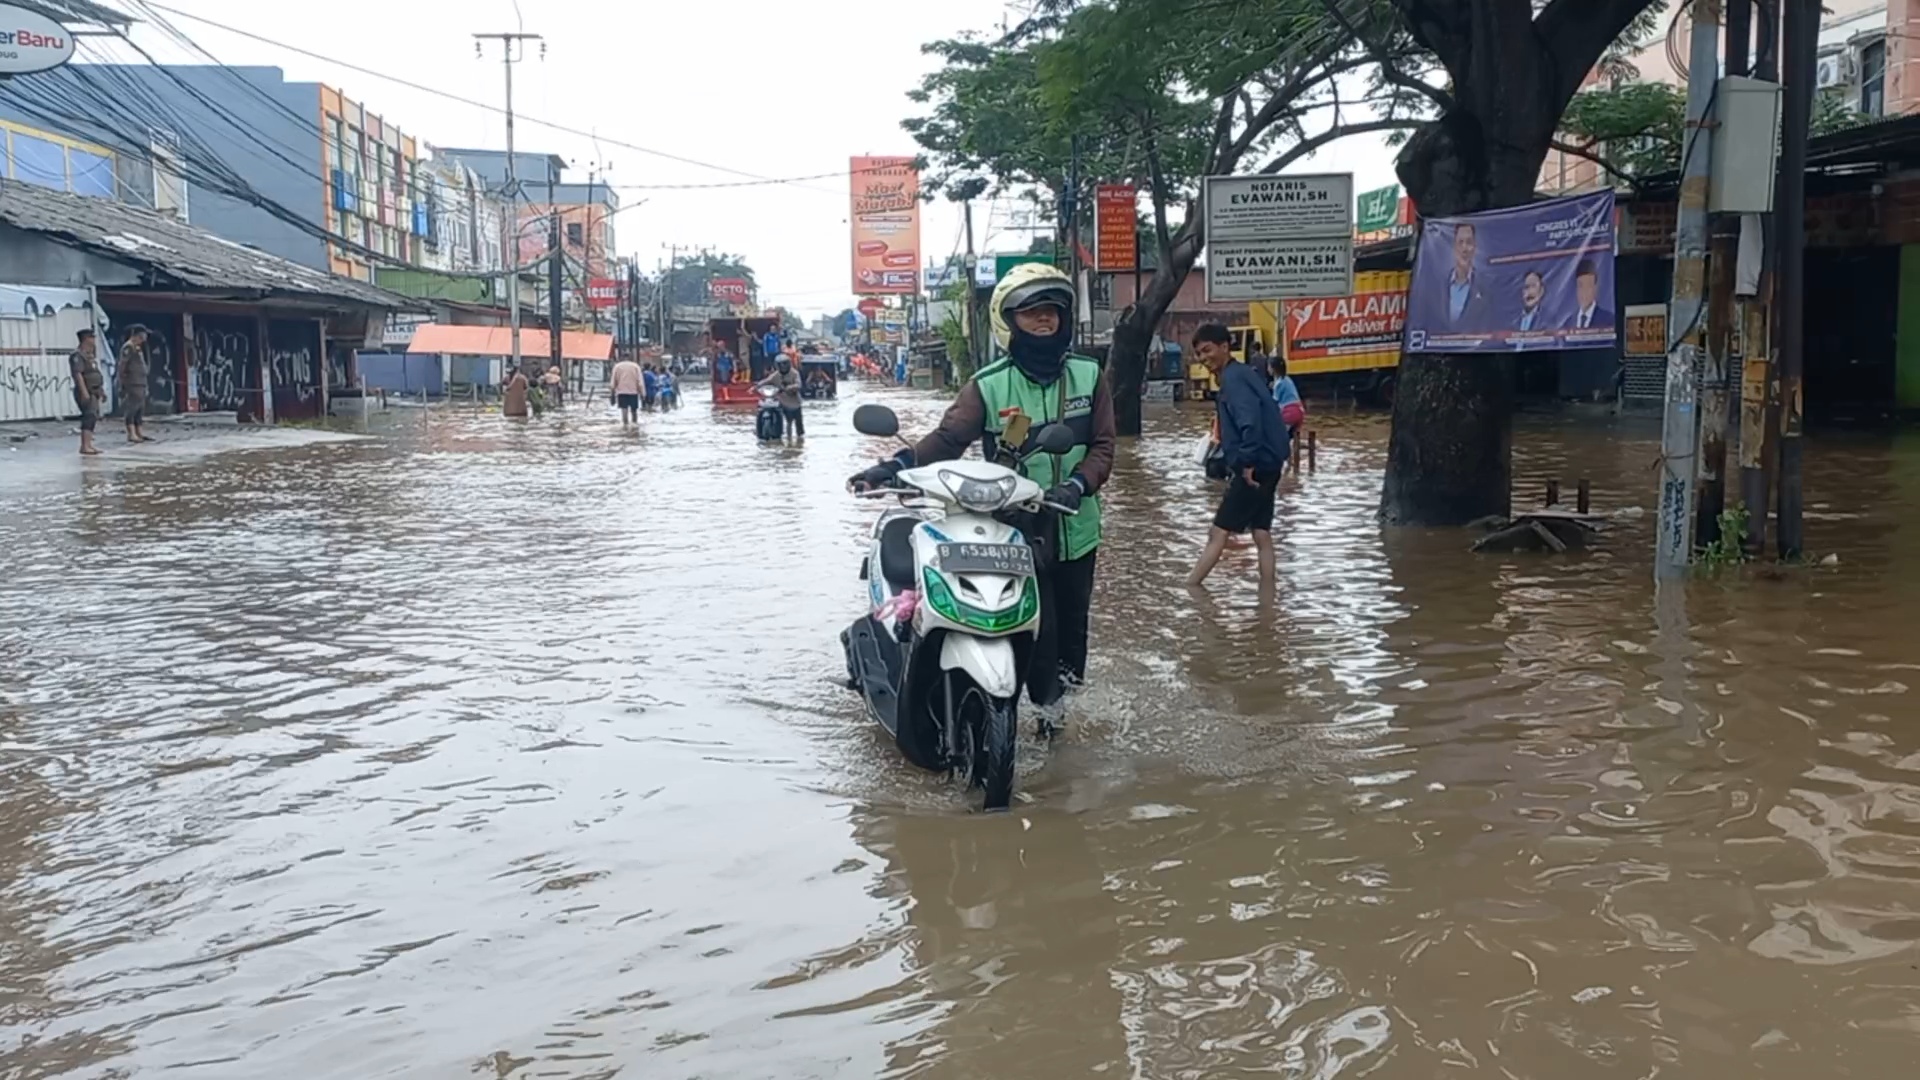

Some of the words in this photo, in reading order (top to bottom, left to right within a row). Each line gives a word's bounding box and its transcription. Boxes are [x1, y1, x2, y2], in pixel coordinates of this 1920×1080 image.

[1251, 181, 1307, 191] NOTARIS
[1231, 191, 1328, 204] EVAWANI,SH
[1225, 254, 1336, 268] EVAWANI,SH
[1279, 267, 1297, 275] KOTA
[1300, 266, 1345, 274] TANGERANG
[1319, 295, 1406, 320] LALAM
[1341, 317, 1388, 334] deliver
[1064, 398, 1090, 410] Grab
[940, 545, 950, 558] B
